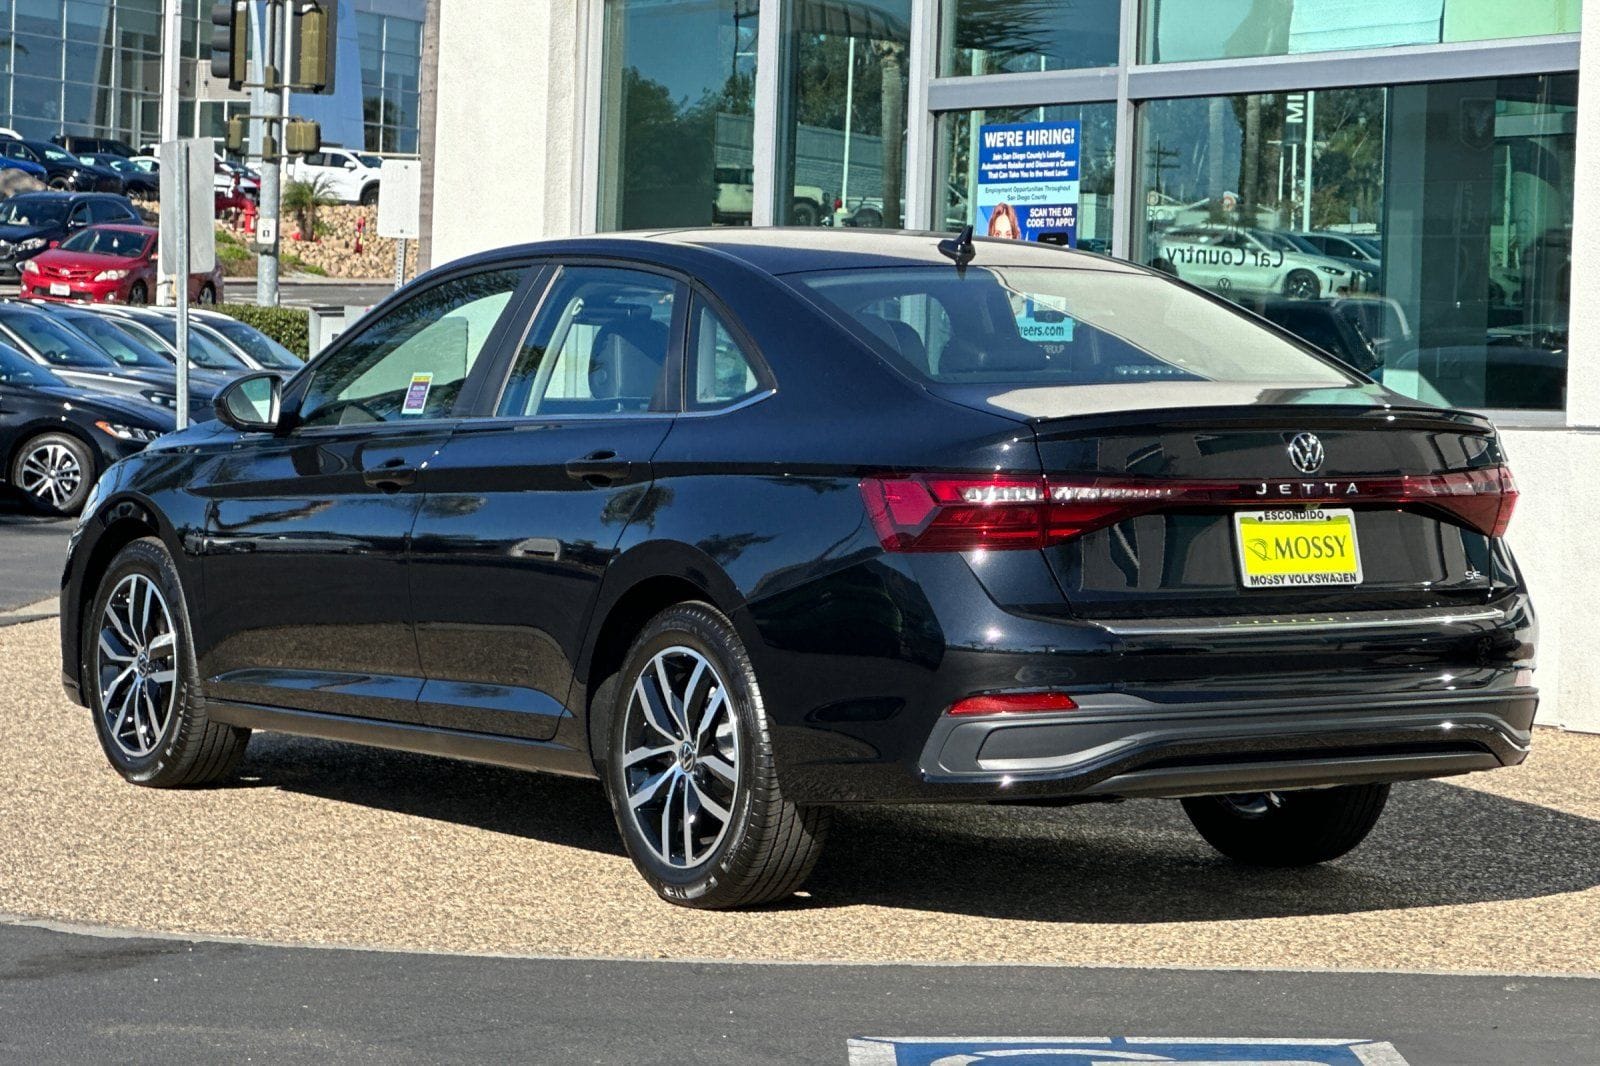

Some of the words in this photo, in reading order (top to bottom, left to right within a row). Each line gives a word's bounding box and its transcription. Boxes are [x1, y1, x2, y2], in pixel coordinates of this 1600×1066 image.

[984, 131, 1024, 148] WE'RE
[1026, 128, 1075, 145] HIRING!
[1003, 152, 1012, 160] San
[1013, 151, 1026, 161] Diego
[1046, 150, 1065, 159] Leading
[1013, 186, 1043, 194] Opportunities
[1045, 184, 1071, 193] Throughout
[1031, 193, 1047, 201] County
[1030, 208, 1047, 217] SCAN
[1048, 207, 1061, 216] THE
[1062, 207, 1073, 216] QR
[1026, 219, 1045, 228] CODE
[1046, 218, 1055, 227] TO
[1055, 217, 1075, 227] APPLY
[1256, 482, 1359, 495] JETTA
[1264, 510, 1325, 520] ESCONDIDO
[1274, 535, 1347, 560] MOSSY
[1250, 574, 1286, 585] MOSSY
[1288, 572, 1357, 585] VOLKSWAGEN
